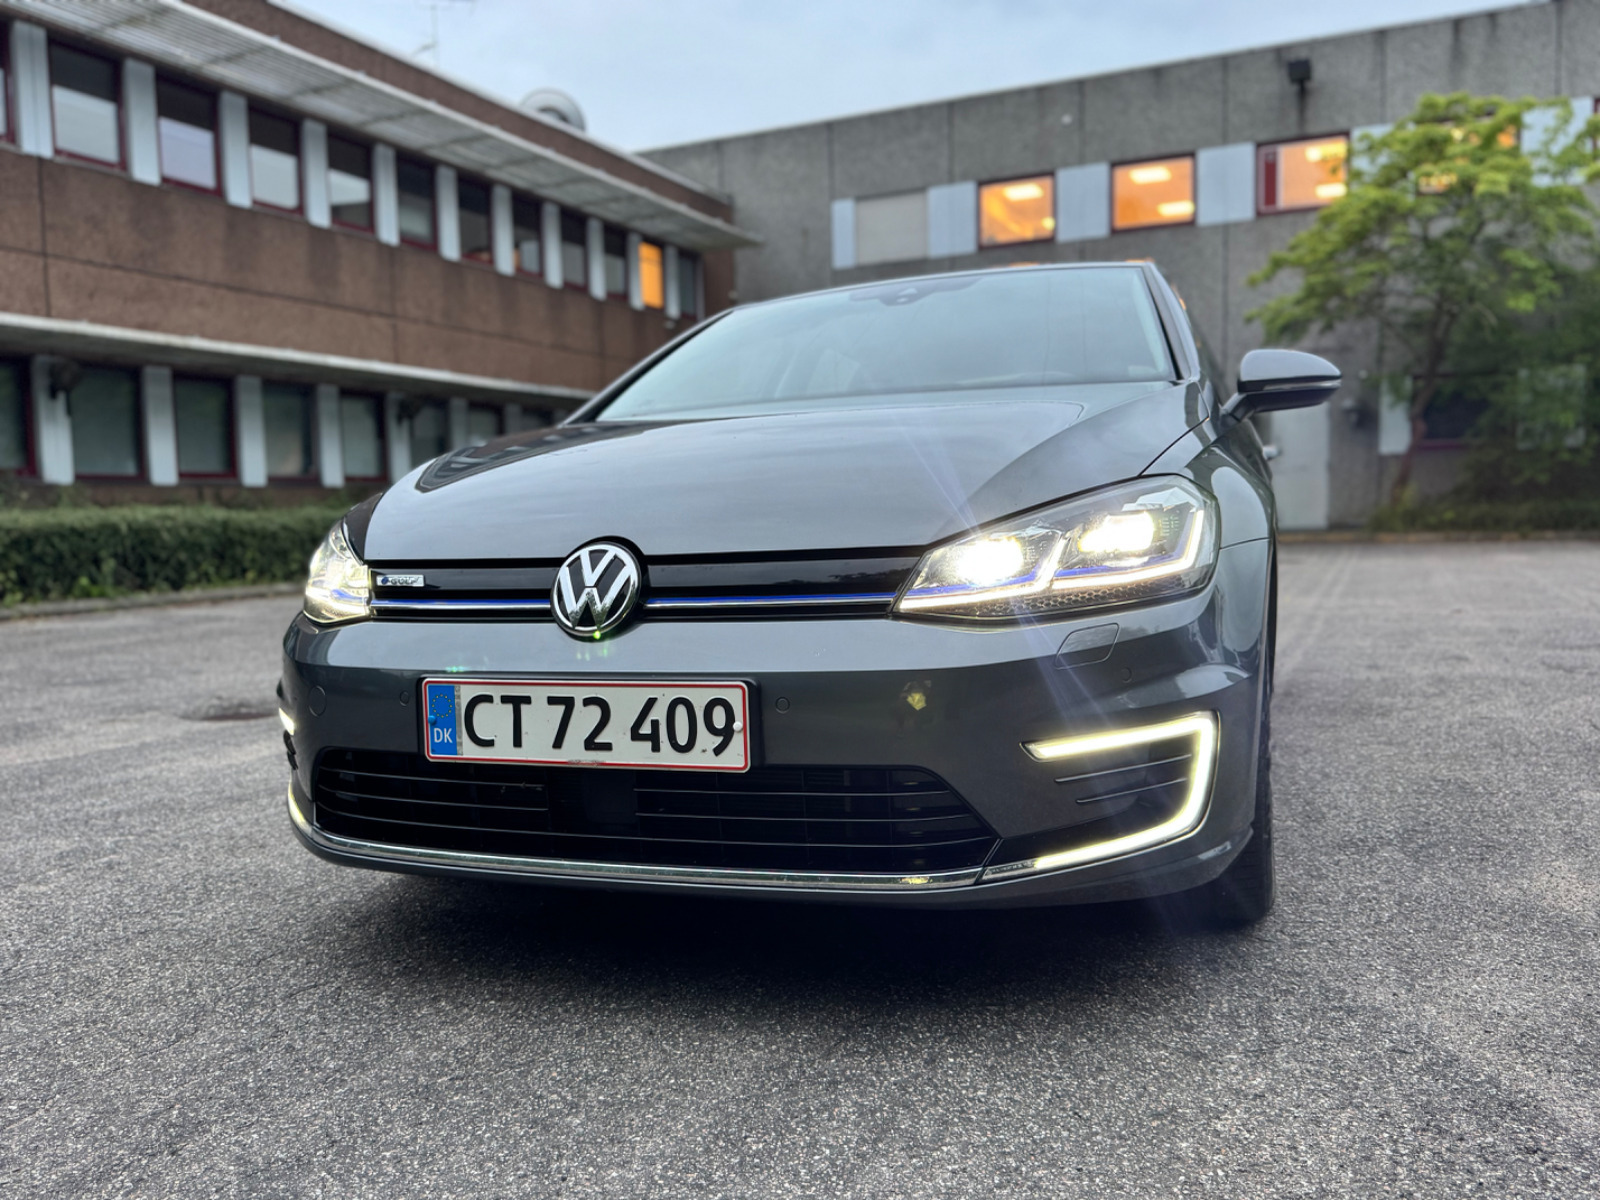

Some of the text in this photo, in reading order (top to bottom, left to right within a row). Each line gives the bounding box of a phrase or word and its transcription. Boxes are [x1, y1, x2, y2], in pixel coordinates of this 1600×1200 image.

[433, 727, 453, 744] DK
[463, 693, 736, 757] CT 72 409
